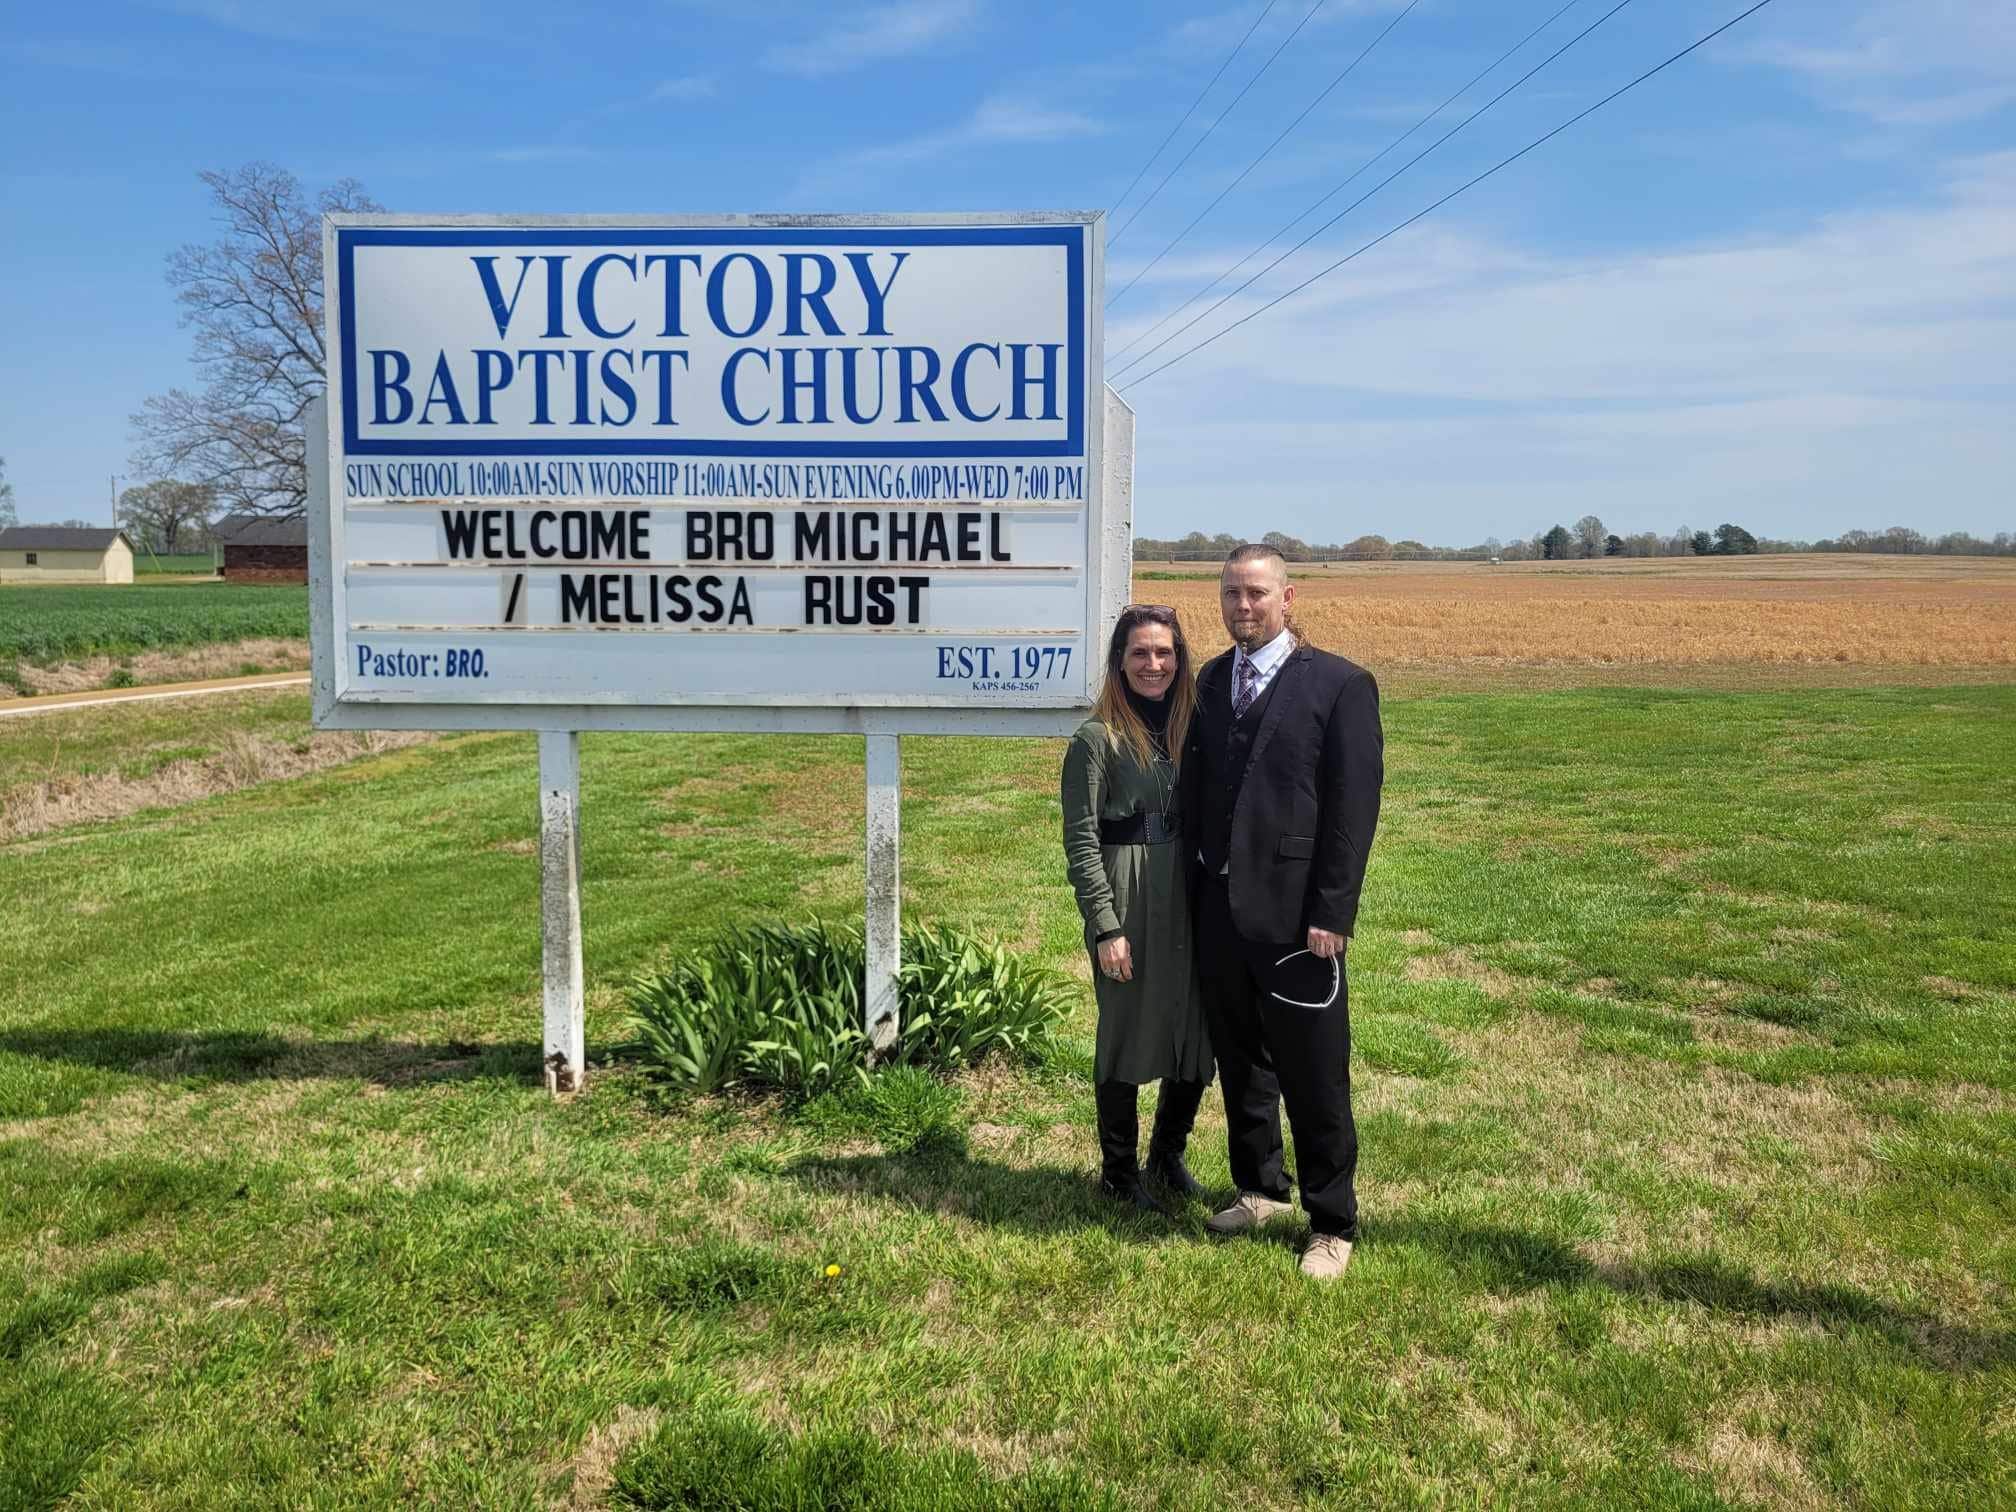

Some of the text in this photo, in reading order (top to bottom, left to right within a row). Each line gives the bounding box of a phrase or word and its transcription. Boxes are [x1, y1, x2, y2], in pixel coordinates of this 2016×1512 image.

[469, 253, 911, 341] VICTORY
[367, 343, 1065, 427] BAPTIST CHURCH
[347, 464, 383, 497] SUN
[387, 462, 465, 498] SCHOOL
[590, 461, 679, 496] WORSHIP
[803, 465, 893, 499] EVENING
[1014, 466, 1049, 499] 7:00
[1053, 466, 1083, 499] PM
[442, 511, 1011, 562] WELCOME BRO MICHAEL
[505, 574, 930, 625] / MELISSA RUST
[357, 645, 489, 678] Pastor: BRO.
[936, 646, 1072, 679] EST. 1977
[1001, 681, 1040, 692] 456-2567
